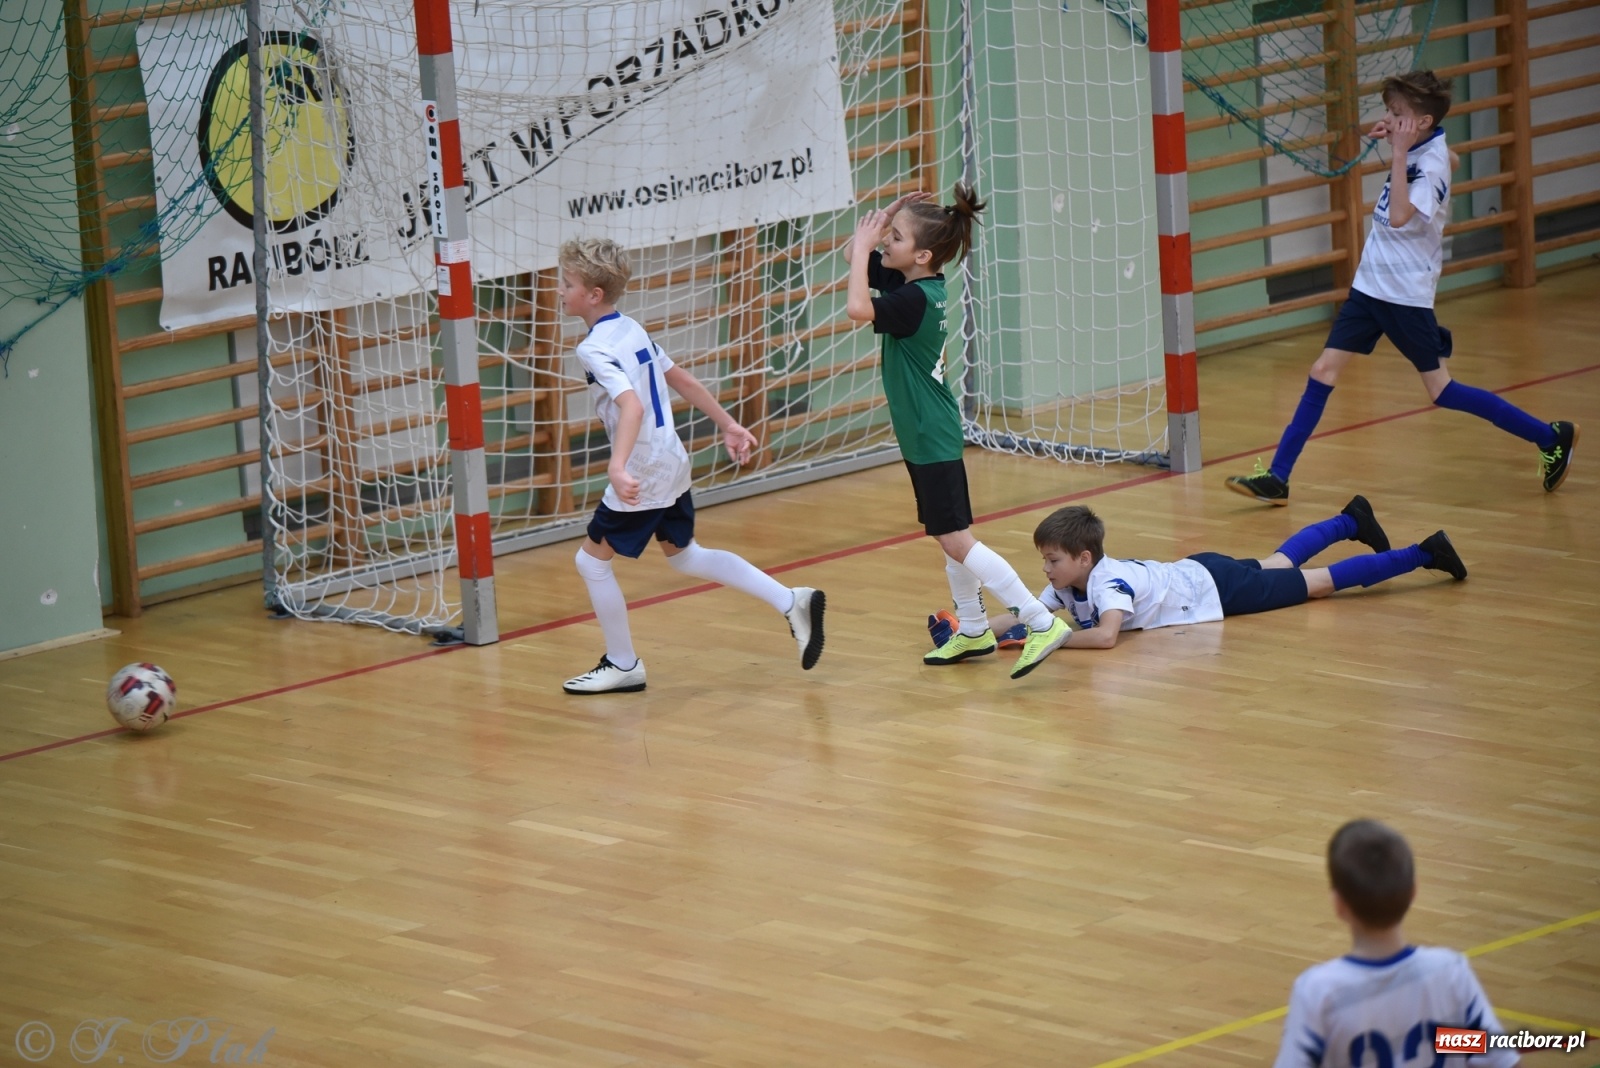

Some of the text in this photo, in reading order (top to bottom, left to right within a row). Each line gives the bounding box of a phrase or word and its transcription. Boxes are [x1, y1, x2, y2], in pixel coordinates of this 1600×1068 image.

[432, 172, 443, 235] sport
[208, 229, 371, 292] RAIBÓRZ
[635, 347, 665, 429] 7
